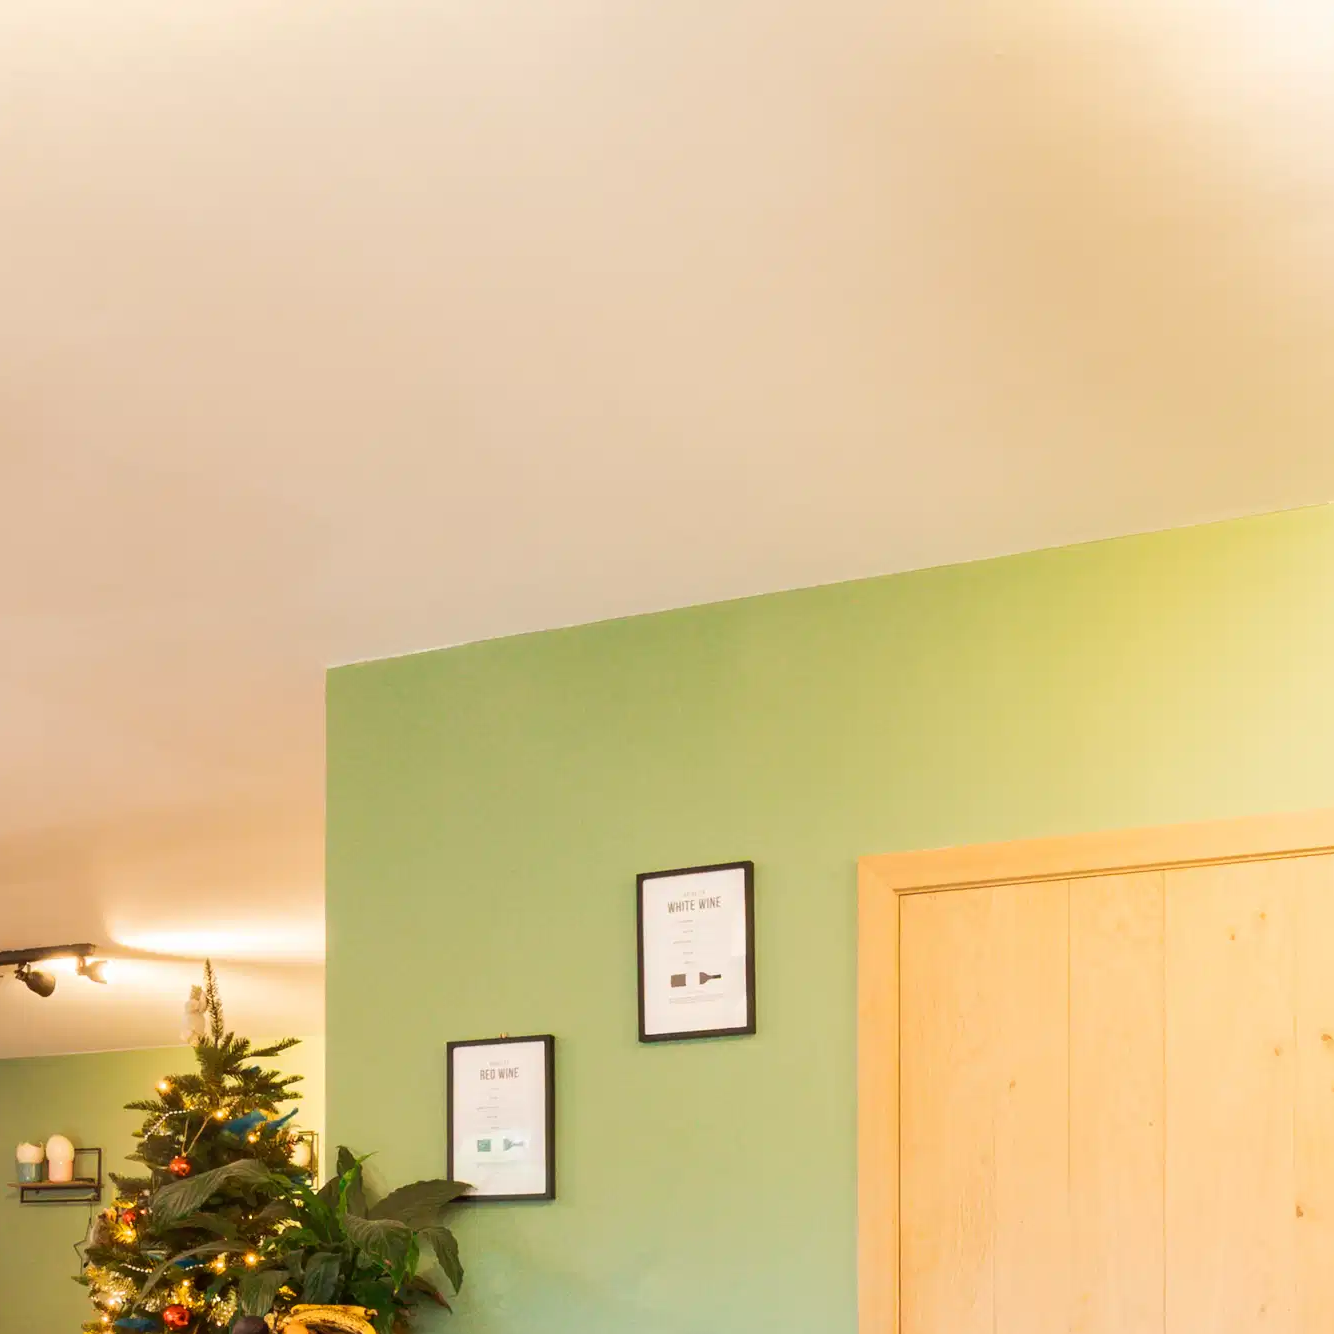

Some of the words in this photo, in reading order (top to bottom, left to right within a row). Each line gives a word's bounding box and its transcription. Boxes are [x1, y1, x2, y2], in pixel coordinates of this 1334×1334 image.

[667, 899, 695, 914] WHITE
[699, 895, 722, 910] WINE
[479, 1069, 496, 1081] RED
[498, 1067, 520, 1080] WINE
